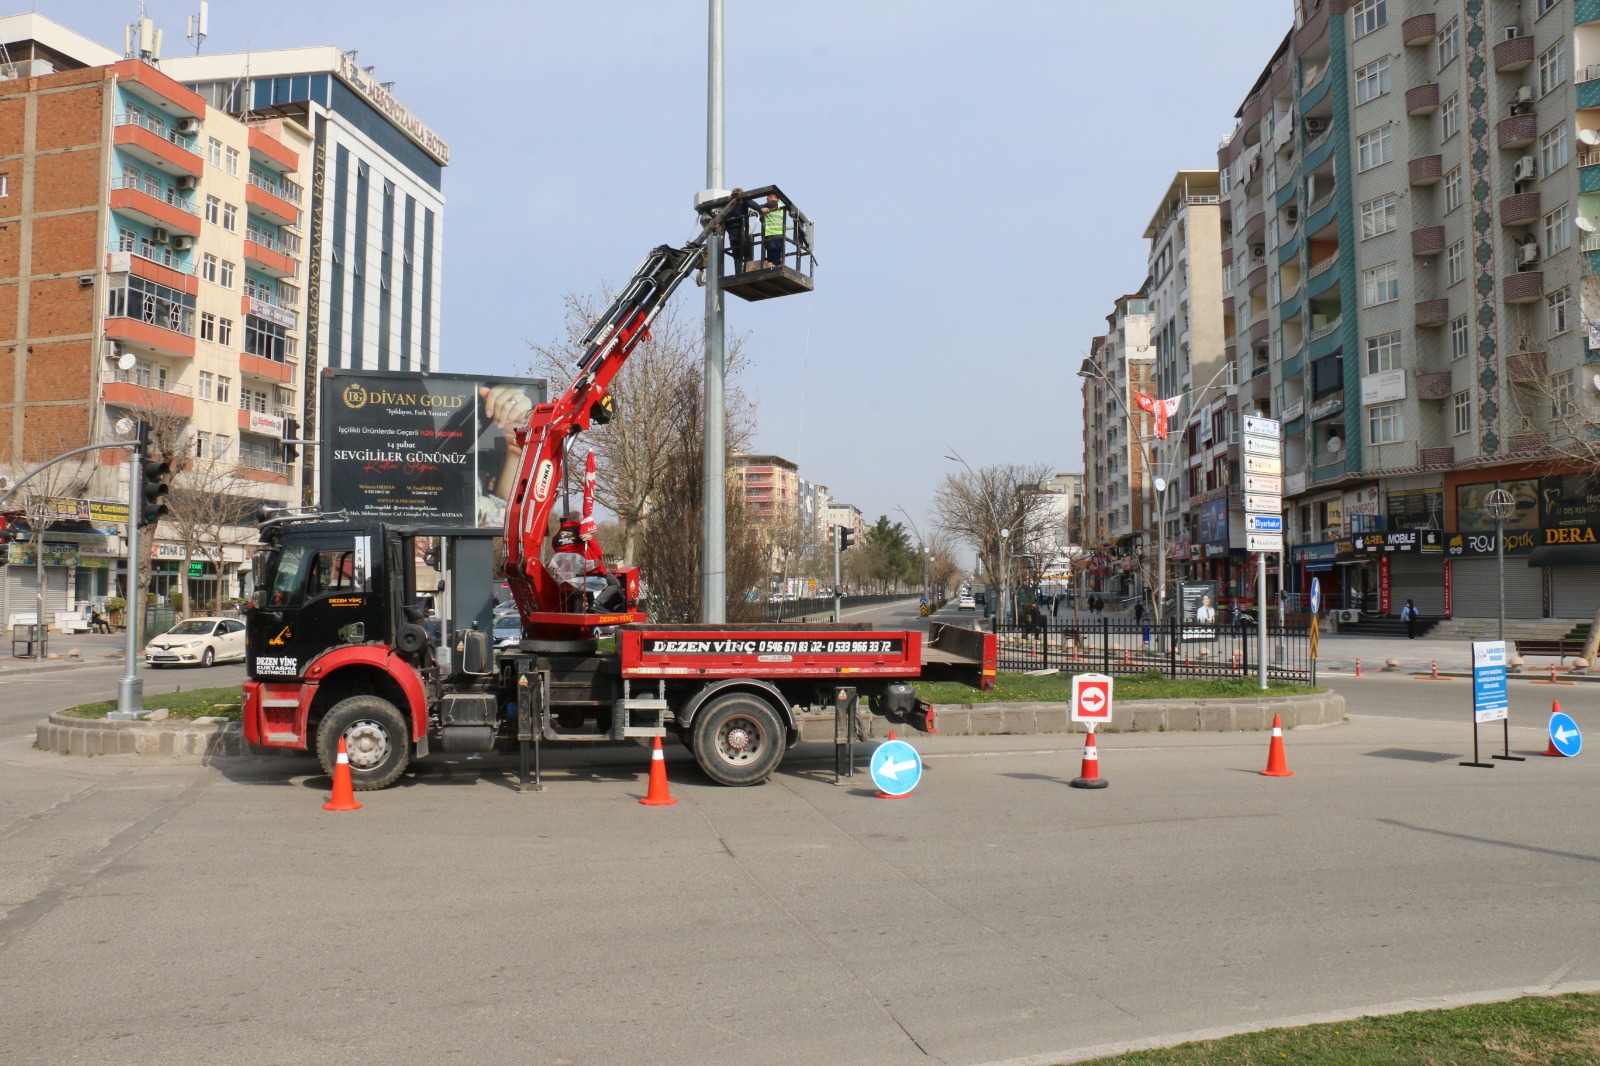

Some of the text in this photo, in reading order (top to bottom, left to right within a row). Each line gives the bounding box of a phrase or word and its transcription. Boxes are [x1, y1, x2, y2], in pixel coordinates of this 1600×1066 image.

[314, 144, 326, 199] HOTEL
[308, 206, 323, 338] MESOPOTAMIA
[369, 389, 462, 408] DİVAN GOLD
[362, 426, 395, 435] Ürünlerde
[396, 428, 419, 437] Geçerli
[396, 441, 416, 450] şubat
[334, 449, 467, 465] SEVGİLİLER GÜNÜNÜZ
[1255, 519, 1280, 529] Diyarbakır
[1364, 535, 1385, 545] AREL
[1545, 527, 1597, 544] DERA
[600, 615, 619, 623] DEZEN
[653, 641, 711, 652] DEZEN
[714, 639, 756, 654] VİNÇ
[759, 641, 766, 652] 0
[766, 641, 783, 652] 546
[798, 642, 808, 652] 83
[827, 641, 834, 652] 0
[835, 641, 851, 652] 533
[851, 641, 868, 652] 966
[868, 641, 879, 652] 33
[256, 656, 298, 667] DEZEN VİNÇ
